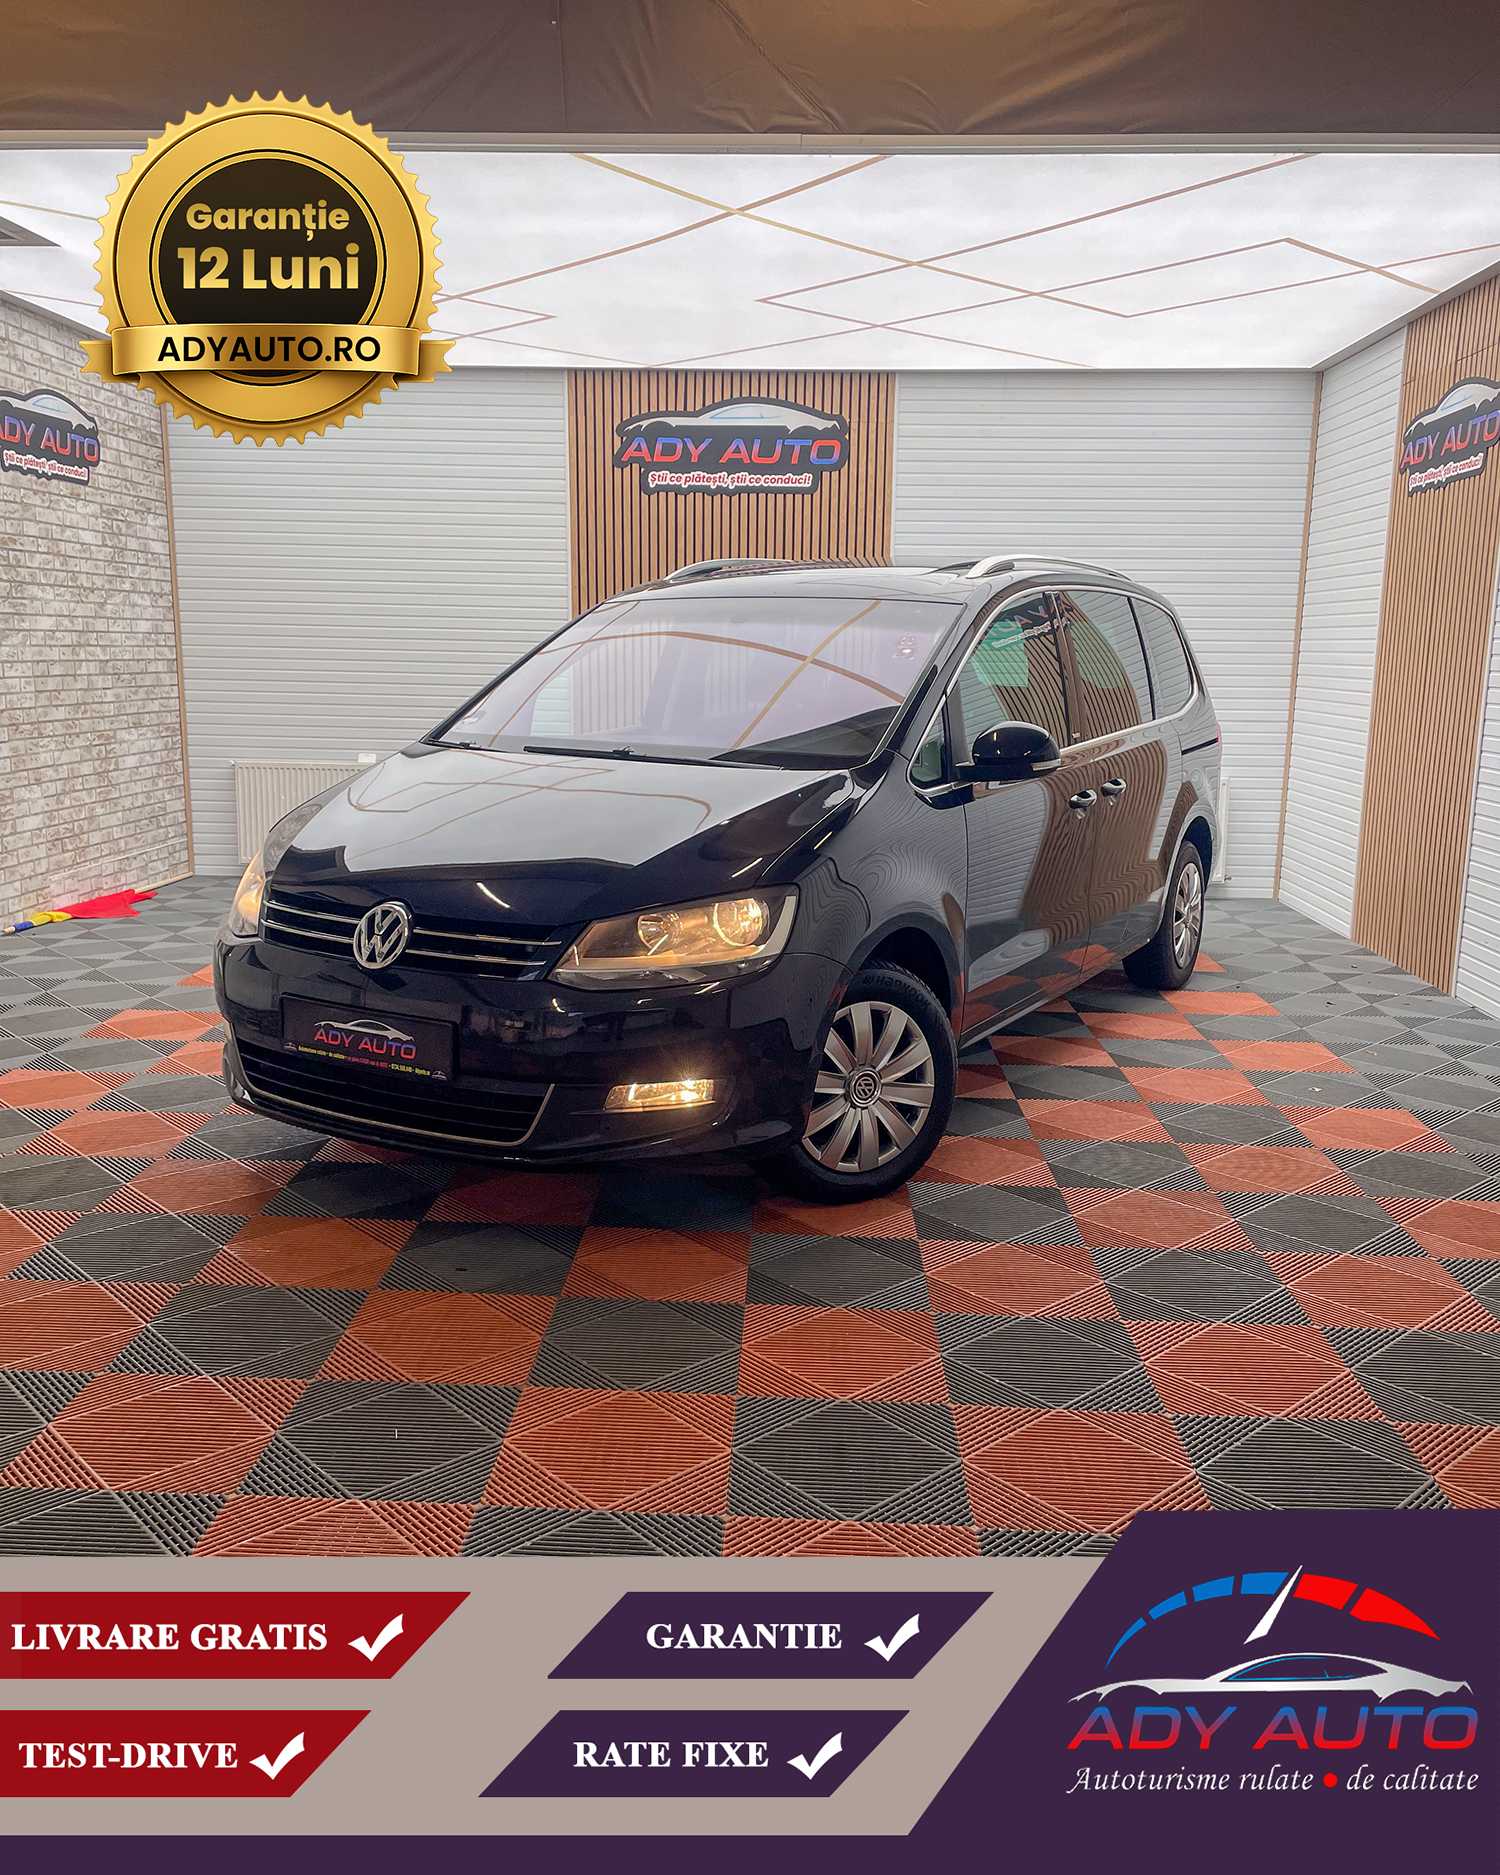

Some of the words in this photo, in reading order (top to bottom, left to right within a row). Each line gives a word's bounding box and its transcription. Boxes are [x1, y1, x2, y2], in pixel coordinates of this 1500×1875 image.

[40, 427, 99, 462] AUTO
[620, 436, 712, 463] ADY
[719, 438, 841, 465] AUTO
[1400, 431, 1440, 469] ADY
[1441, 410, 1500, 456] AUTO
[669, 475, 682, 483] ce
[748, 476, 761, 484] ce
[763, 475, 811, 485] conduci!
[314, 1028, 355, 1047] ADY
[358, 1036, 416, 1060] AUTO
